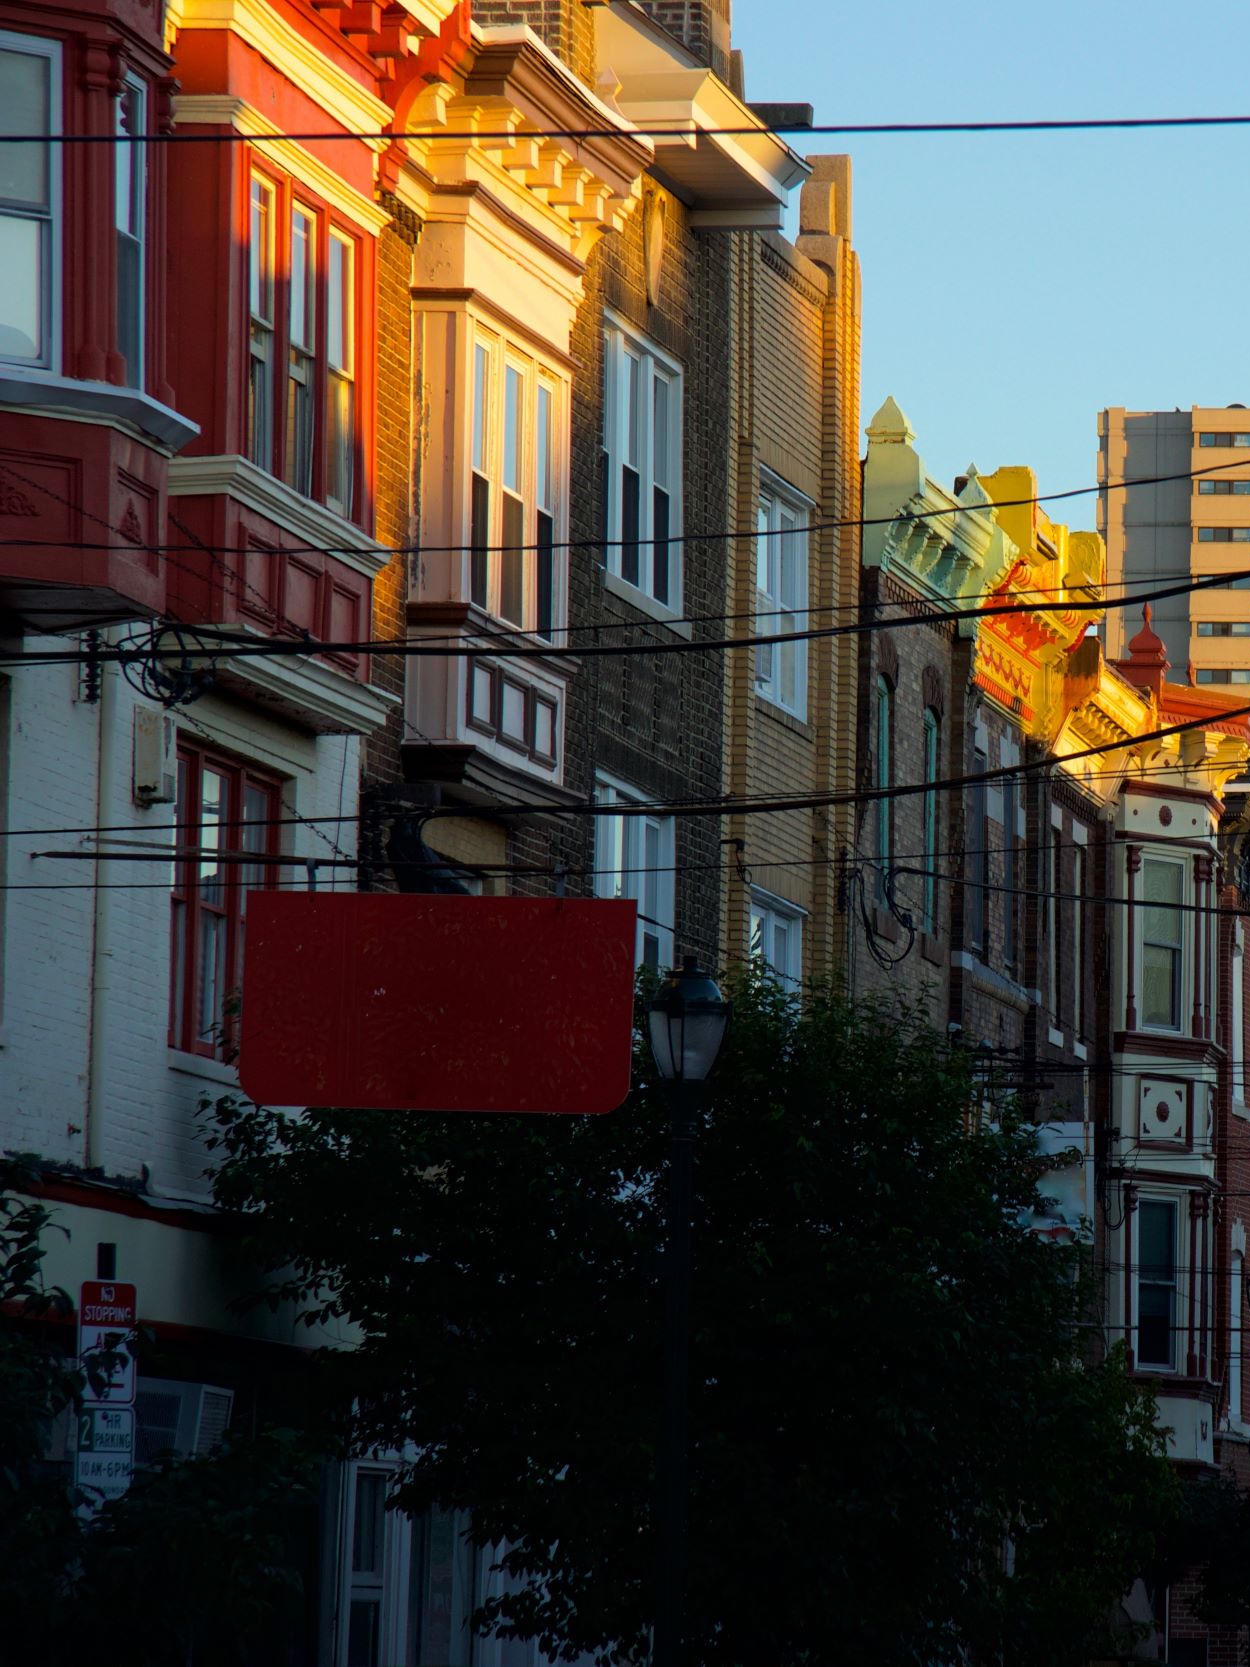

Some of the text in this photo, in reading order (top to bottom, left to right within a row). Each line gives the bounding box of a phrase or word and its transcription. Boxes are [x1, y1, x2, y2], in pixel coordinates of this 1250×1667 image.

[100, 1286, 115, 1302] NO
[85, 1306, 132, 1321] STOPPING
[81, 1414, 121, 1446] 2 HR
[95, 1432, 131, 1449] PARKING
